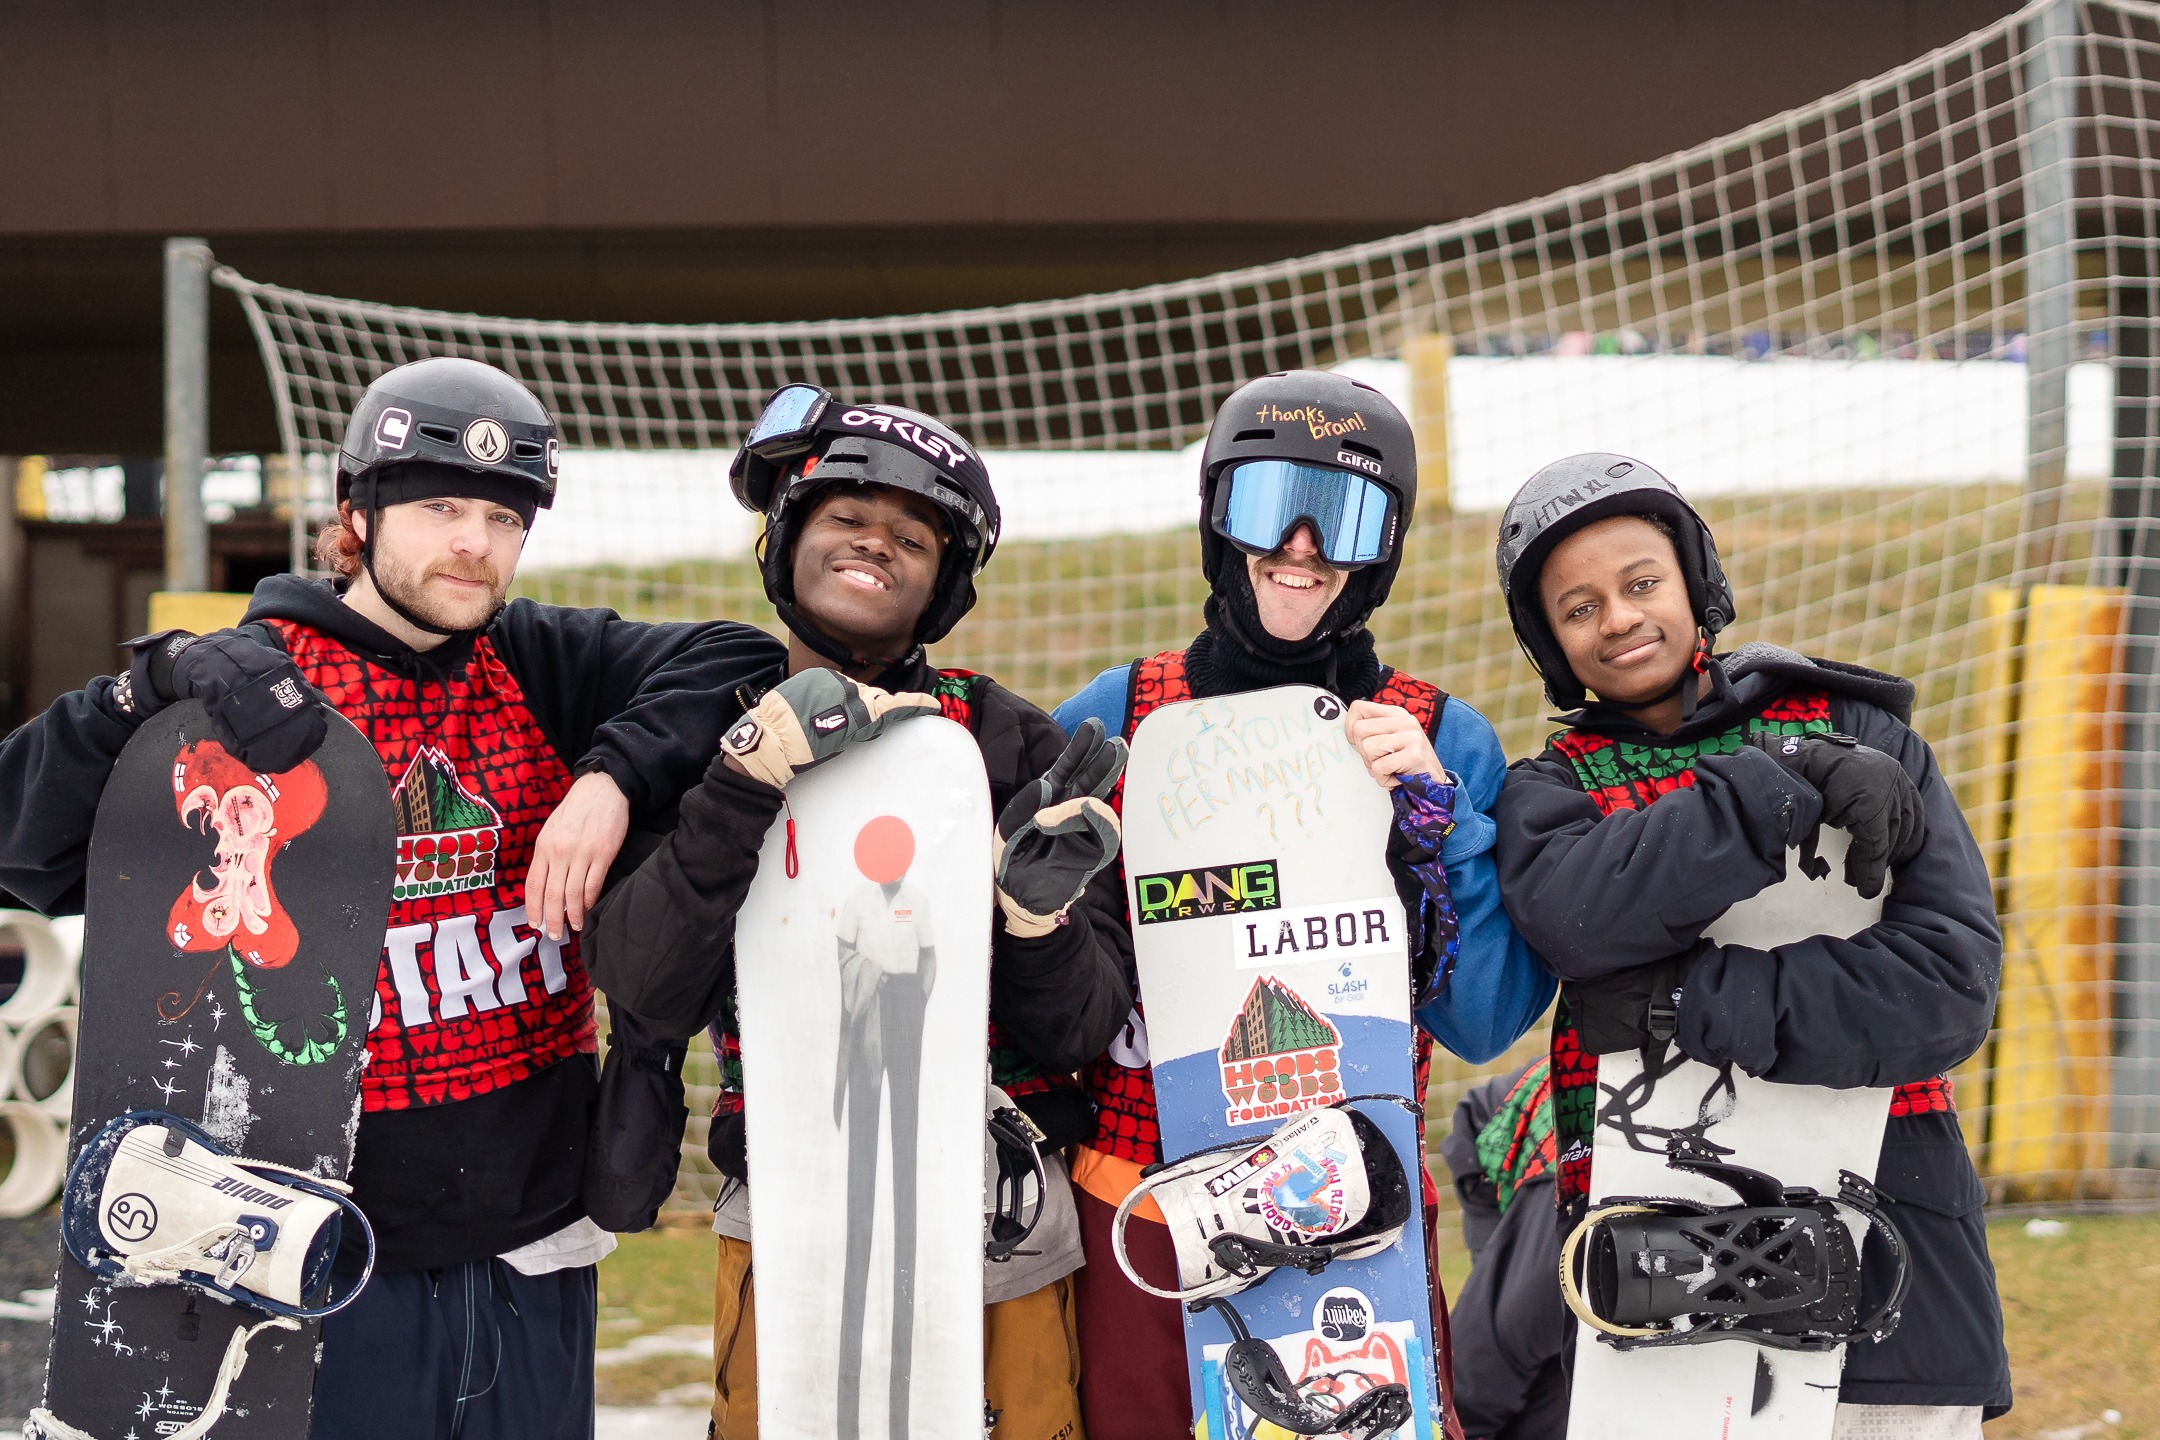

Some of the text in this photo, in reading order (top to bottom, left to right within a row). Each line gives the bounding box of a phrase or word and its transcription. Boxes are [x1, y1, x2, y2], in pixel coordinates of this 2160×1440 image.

[1256, 404, 1325, 424] thanks
[1309, 412, 1367, 440] brain!
[841, 410, 967, 469] OAKLEY
[1337, 451, 1382, 475] GIRO
[933, 485, 971, 513] GIRO
[1532, 479, 1611, 529] HTW XL
[1168, 705, 1312, 785] CRAYON
[396, 829, 498, 862] HOODS
[396, 852, 495, 883] WOODS
[393, 872, 494, 900] OUNDATION
[1138, 863, 1275, 913] DANG
[1142, 896, 1277, 922] AIRWEAR
[1246, 909, 1390, 958] LABOR
[369, 904, 571, 1033] TAFF
[1327, 979, 1368, 995] SLASH
[1334, 994, 1345, 1004] BY
[1223, 1048, 1338, 1089] HOODS
[1263, 1073, 1290, 1088] TO
[1225, 1071, 1341, 1108] WOODS
[1229, 1092, 1344, 1124] FOUNDATION
[213, 1176, 294, 1210] public
[1261, 1201, 1292, 1231] HOOD
[1559, 1253, 1569, 1294] RIDE
[158, 1403, 204, 1412] BLOSSOM
[166, 1409, 194, 1417] BURTON
